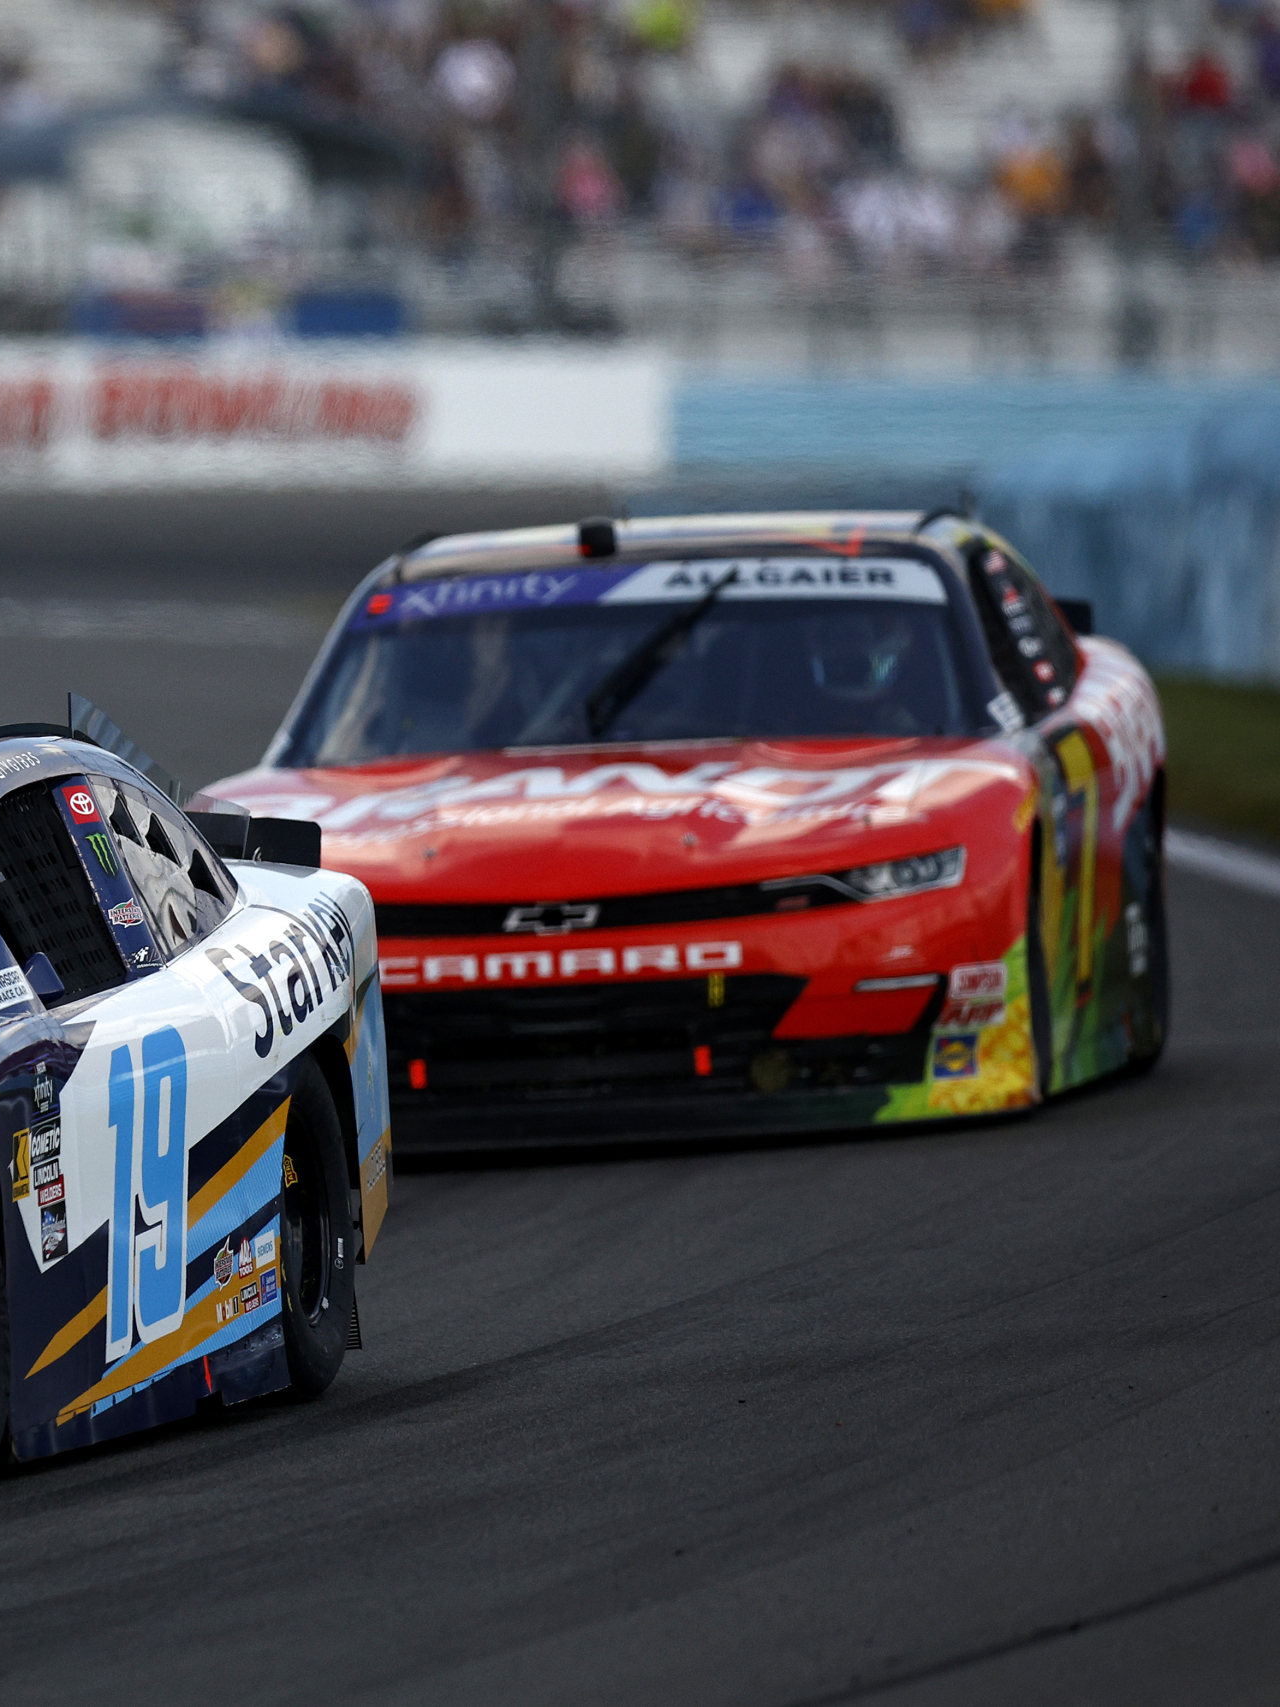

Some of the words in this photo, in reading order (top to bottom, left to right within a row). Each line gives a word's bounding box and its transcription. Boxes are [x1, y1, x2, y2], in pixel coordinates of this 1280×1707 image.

[399, 572, 578, 616] xfinity
[379, 941, 742, 986] CAMARO
[14, 985, 29, 997] CAR
[31, 1124, 61, 1158] COMETIC
[35, 1161, 59, 1187] LINCOLN
[107, 1024, 188, 1350] 19
[39, 1183, 63, 1205] WELDERS
[215, 1298, 234, 1323] Mobil
